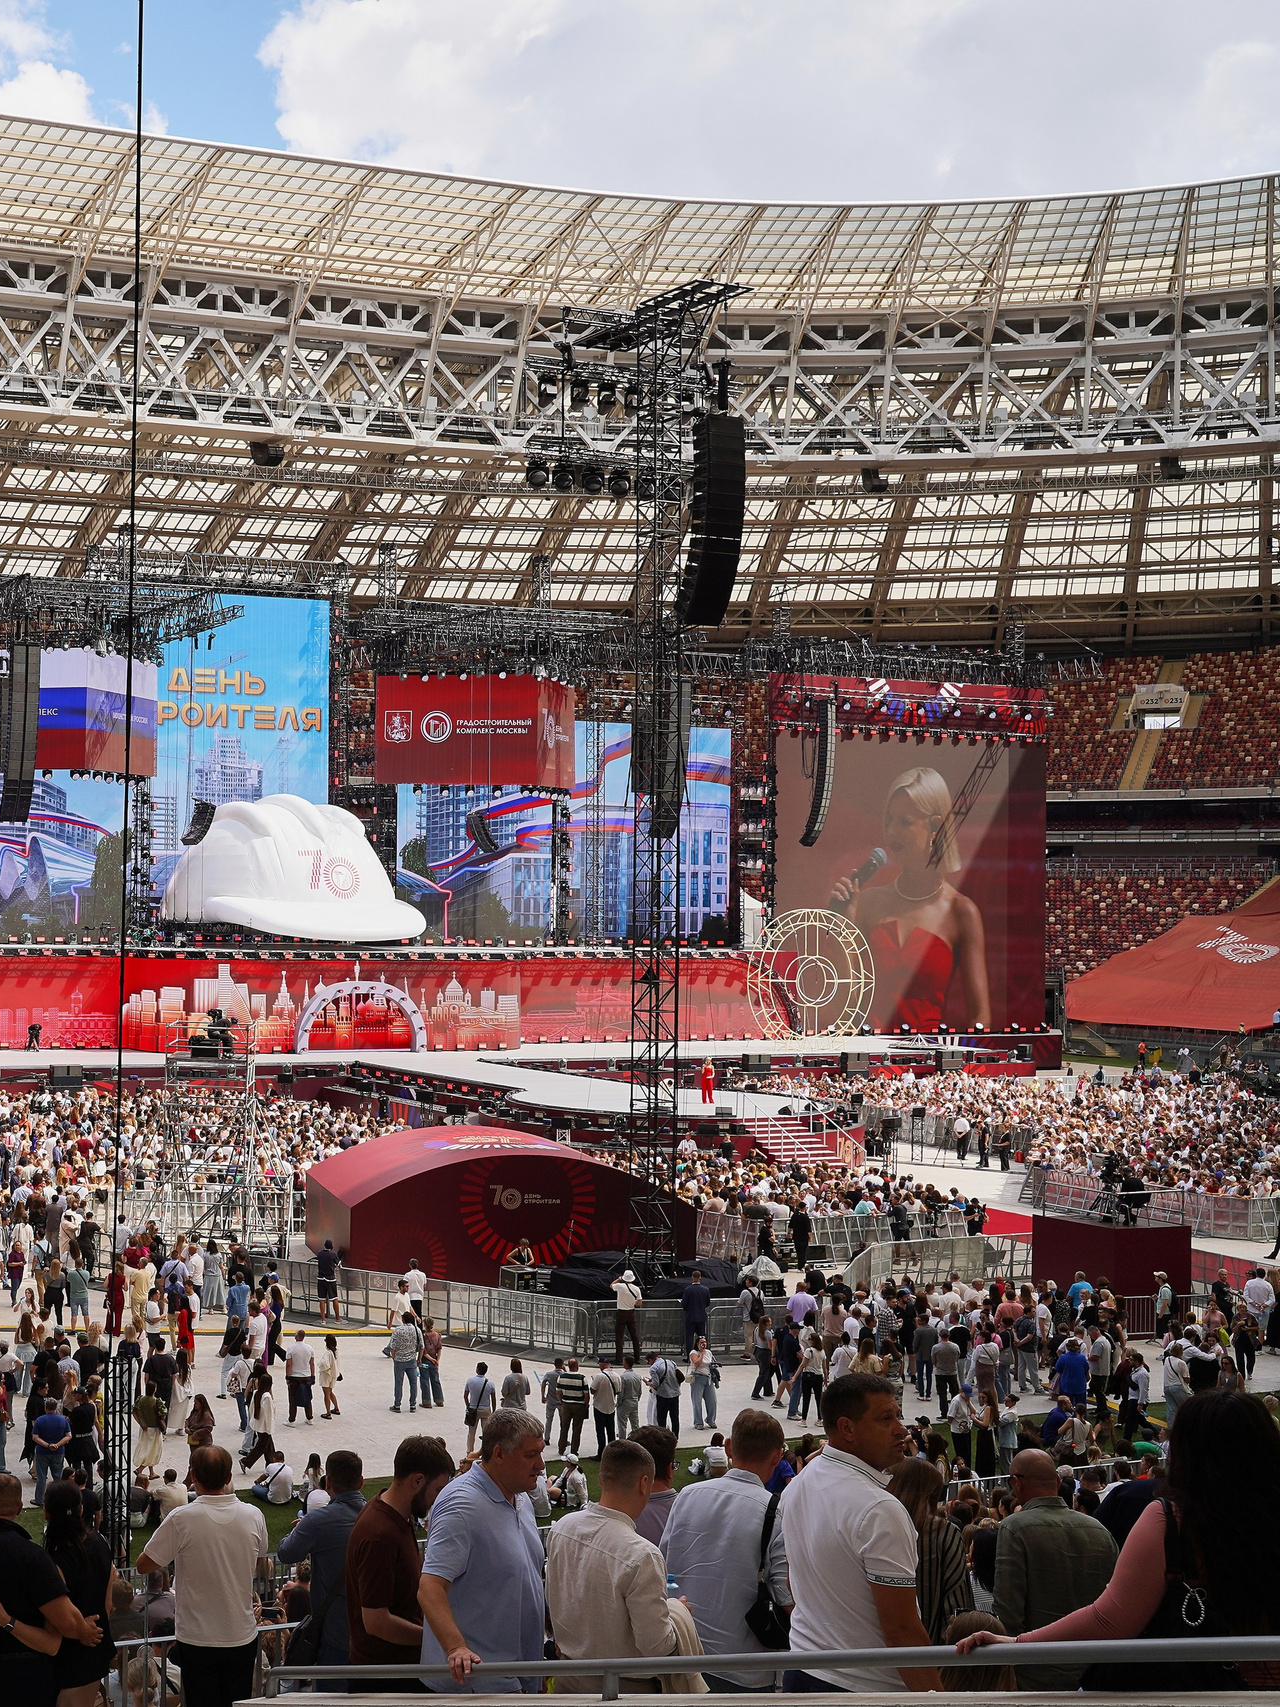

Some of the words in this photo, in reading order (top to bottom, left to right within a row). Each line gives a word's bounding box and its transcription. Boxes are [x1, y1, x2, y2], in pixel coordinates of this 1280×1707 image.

[167, 667, 266, 695] ДЕНЬ
[157, 700, 322, 732] РОИТЕЛЯ
[456, 718, 532, 727] ГРАДОСТРОИТЕЛЬНЫЙ
[489, 1184, 522, 1210] 70
